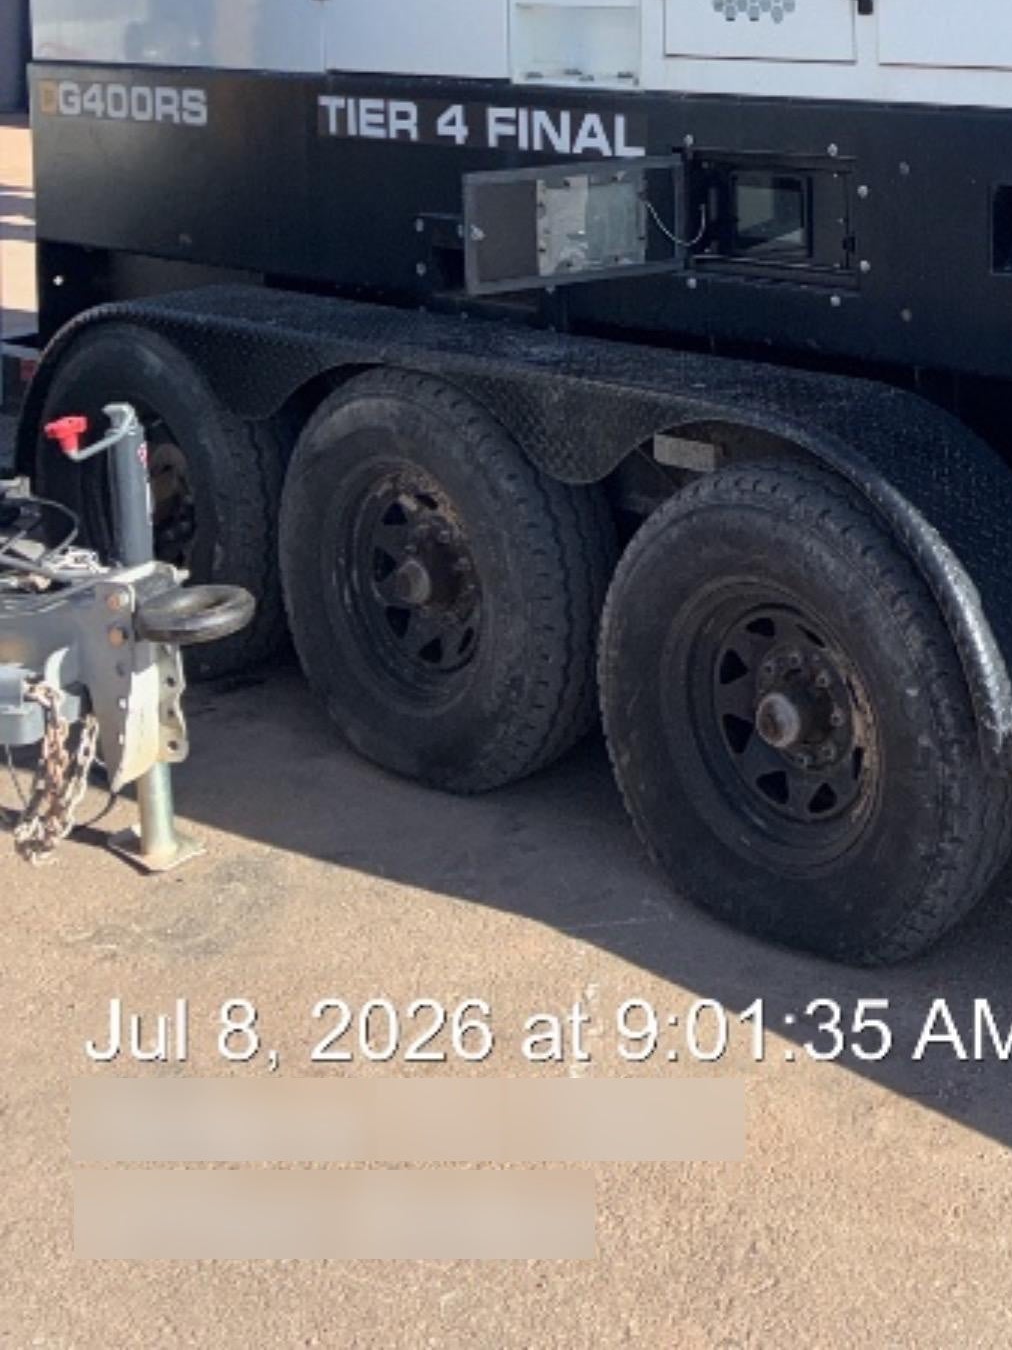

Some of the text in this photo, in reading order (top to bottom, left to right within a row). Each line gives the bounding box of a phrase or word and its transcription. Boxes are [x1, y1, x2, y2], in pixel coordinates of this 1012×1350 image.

[58, 80, 208, 126] G400RS
[318, 95, 646, 157] TIER 4 FINAL
